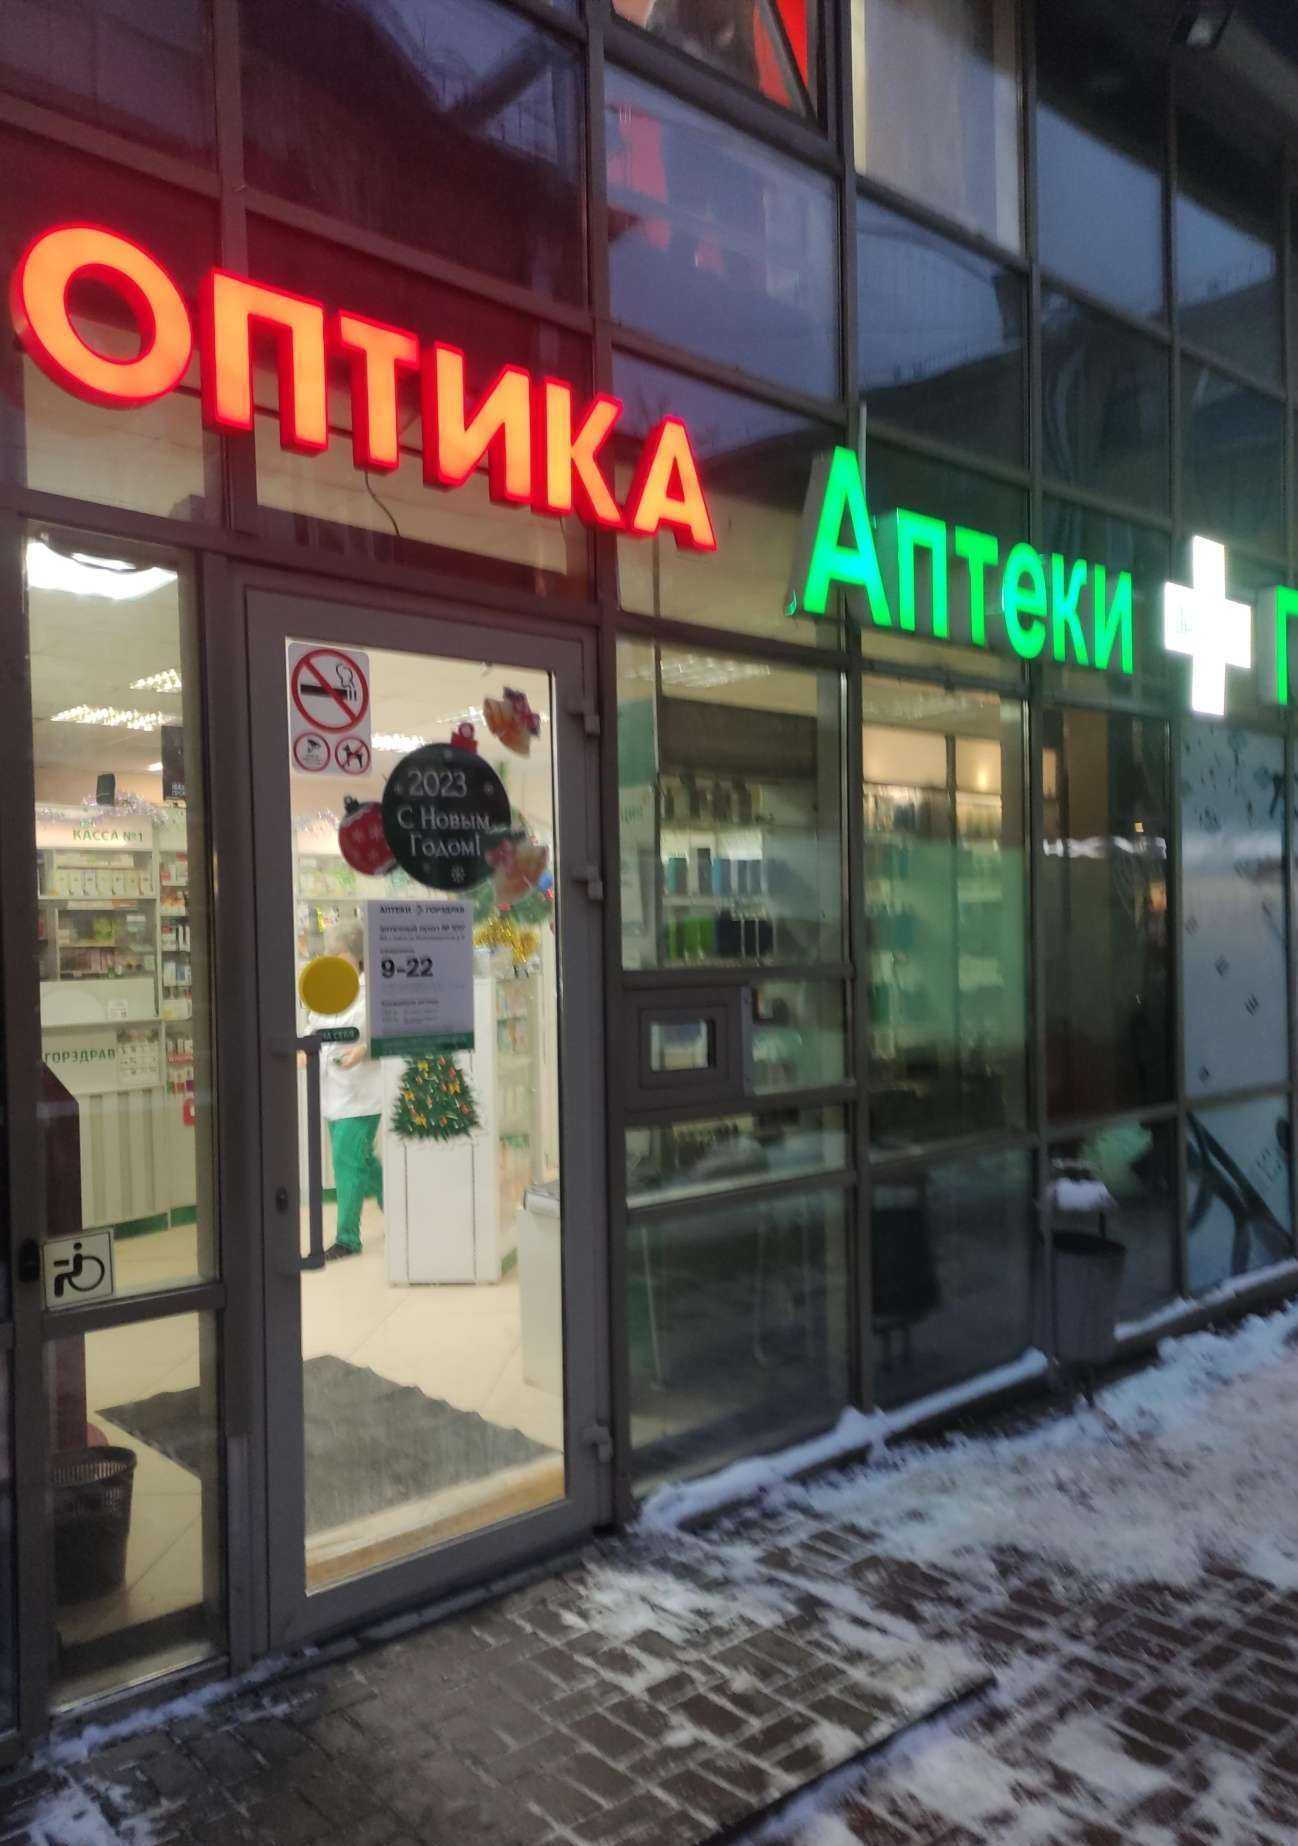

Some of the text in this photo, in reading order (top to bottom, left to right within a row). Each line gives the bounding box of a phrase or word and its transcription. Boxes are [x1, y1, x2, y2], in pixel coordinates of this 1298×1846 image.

[11, 222, 717, 553] ОПТИКА
[407, 770, 468, 798] 2023
[397, 804, 491, 831] С Новым
[72, 828, 119, 842] КАССА
[380, 956, 434, 979] 9-22
